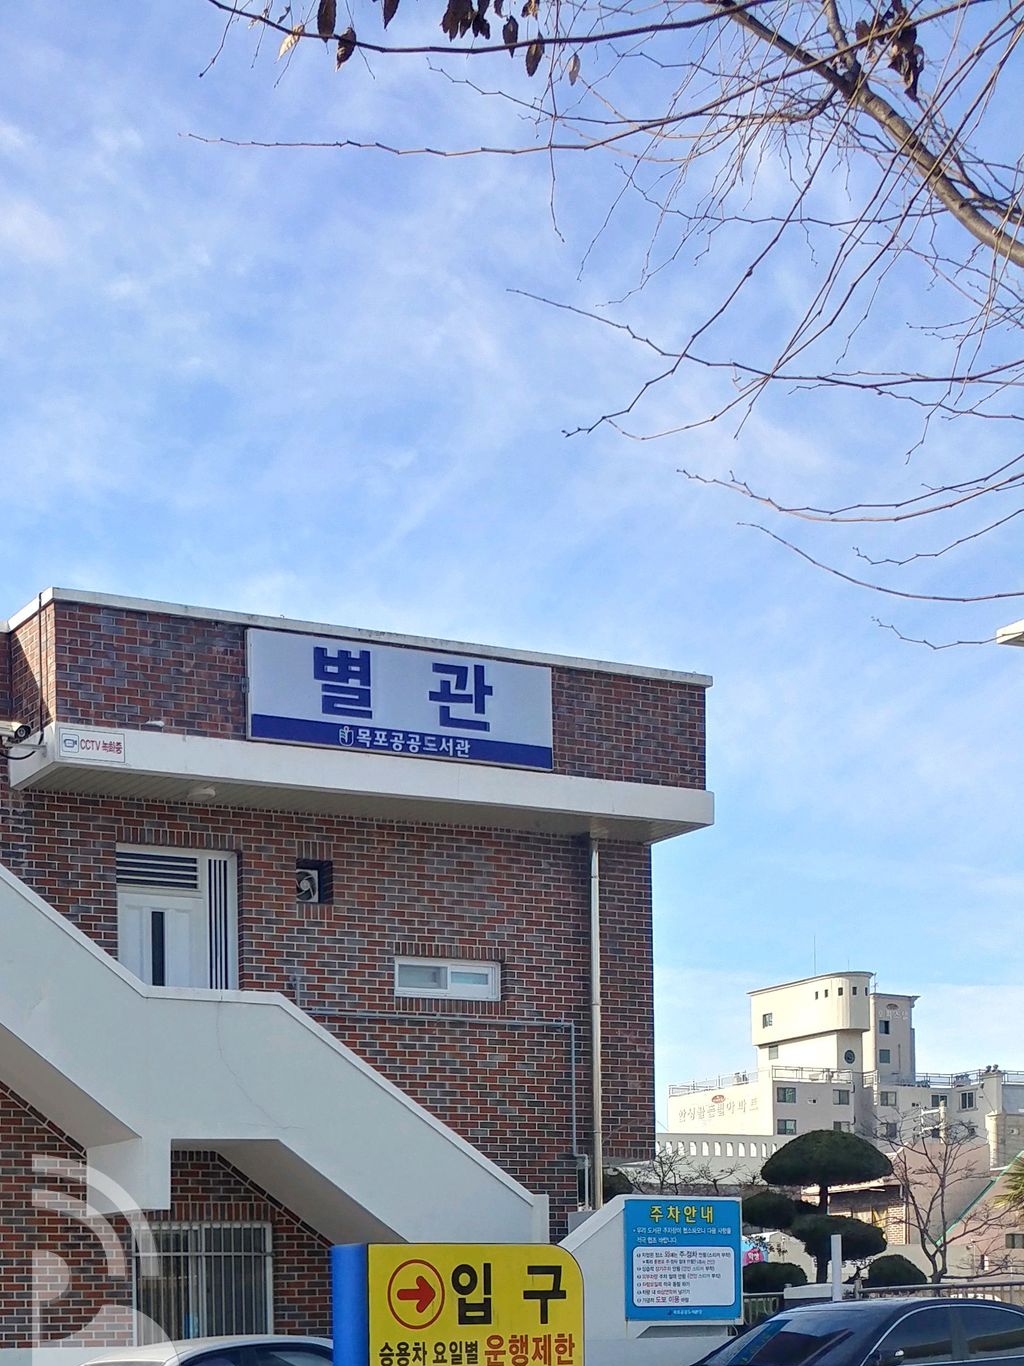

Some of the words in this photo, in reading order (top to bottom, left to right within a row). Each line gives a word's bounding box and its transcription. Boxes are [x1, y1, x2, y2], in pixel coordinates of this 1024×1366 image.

[79, 738, 101, 751] CCTV
[356, 728, 471, 759] 목포공공도서관
[649, 1205, 714, 1224] 주차안내
[432, 1340, 479, 1366] 요일별
